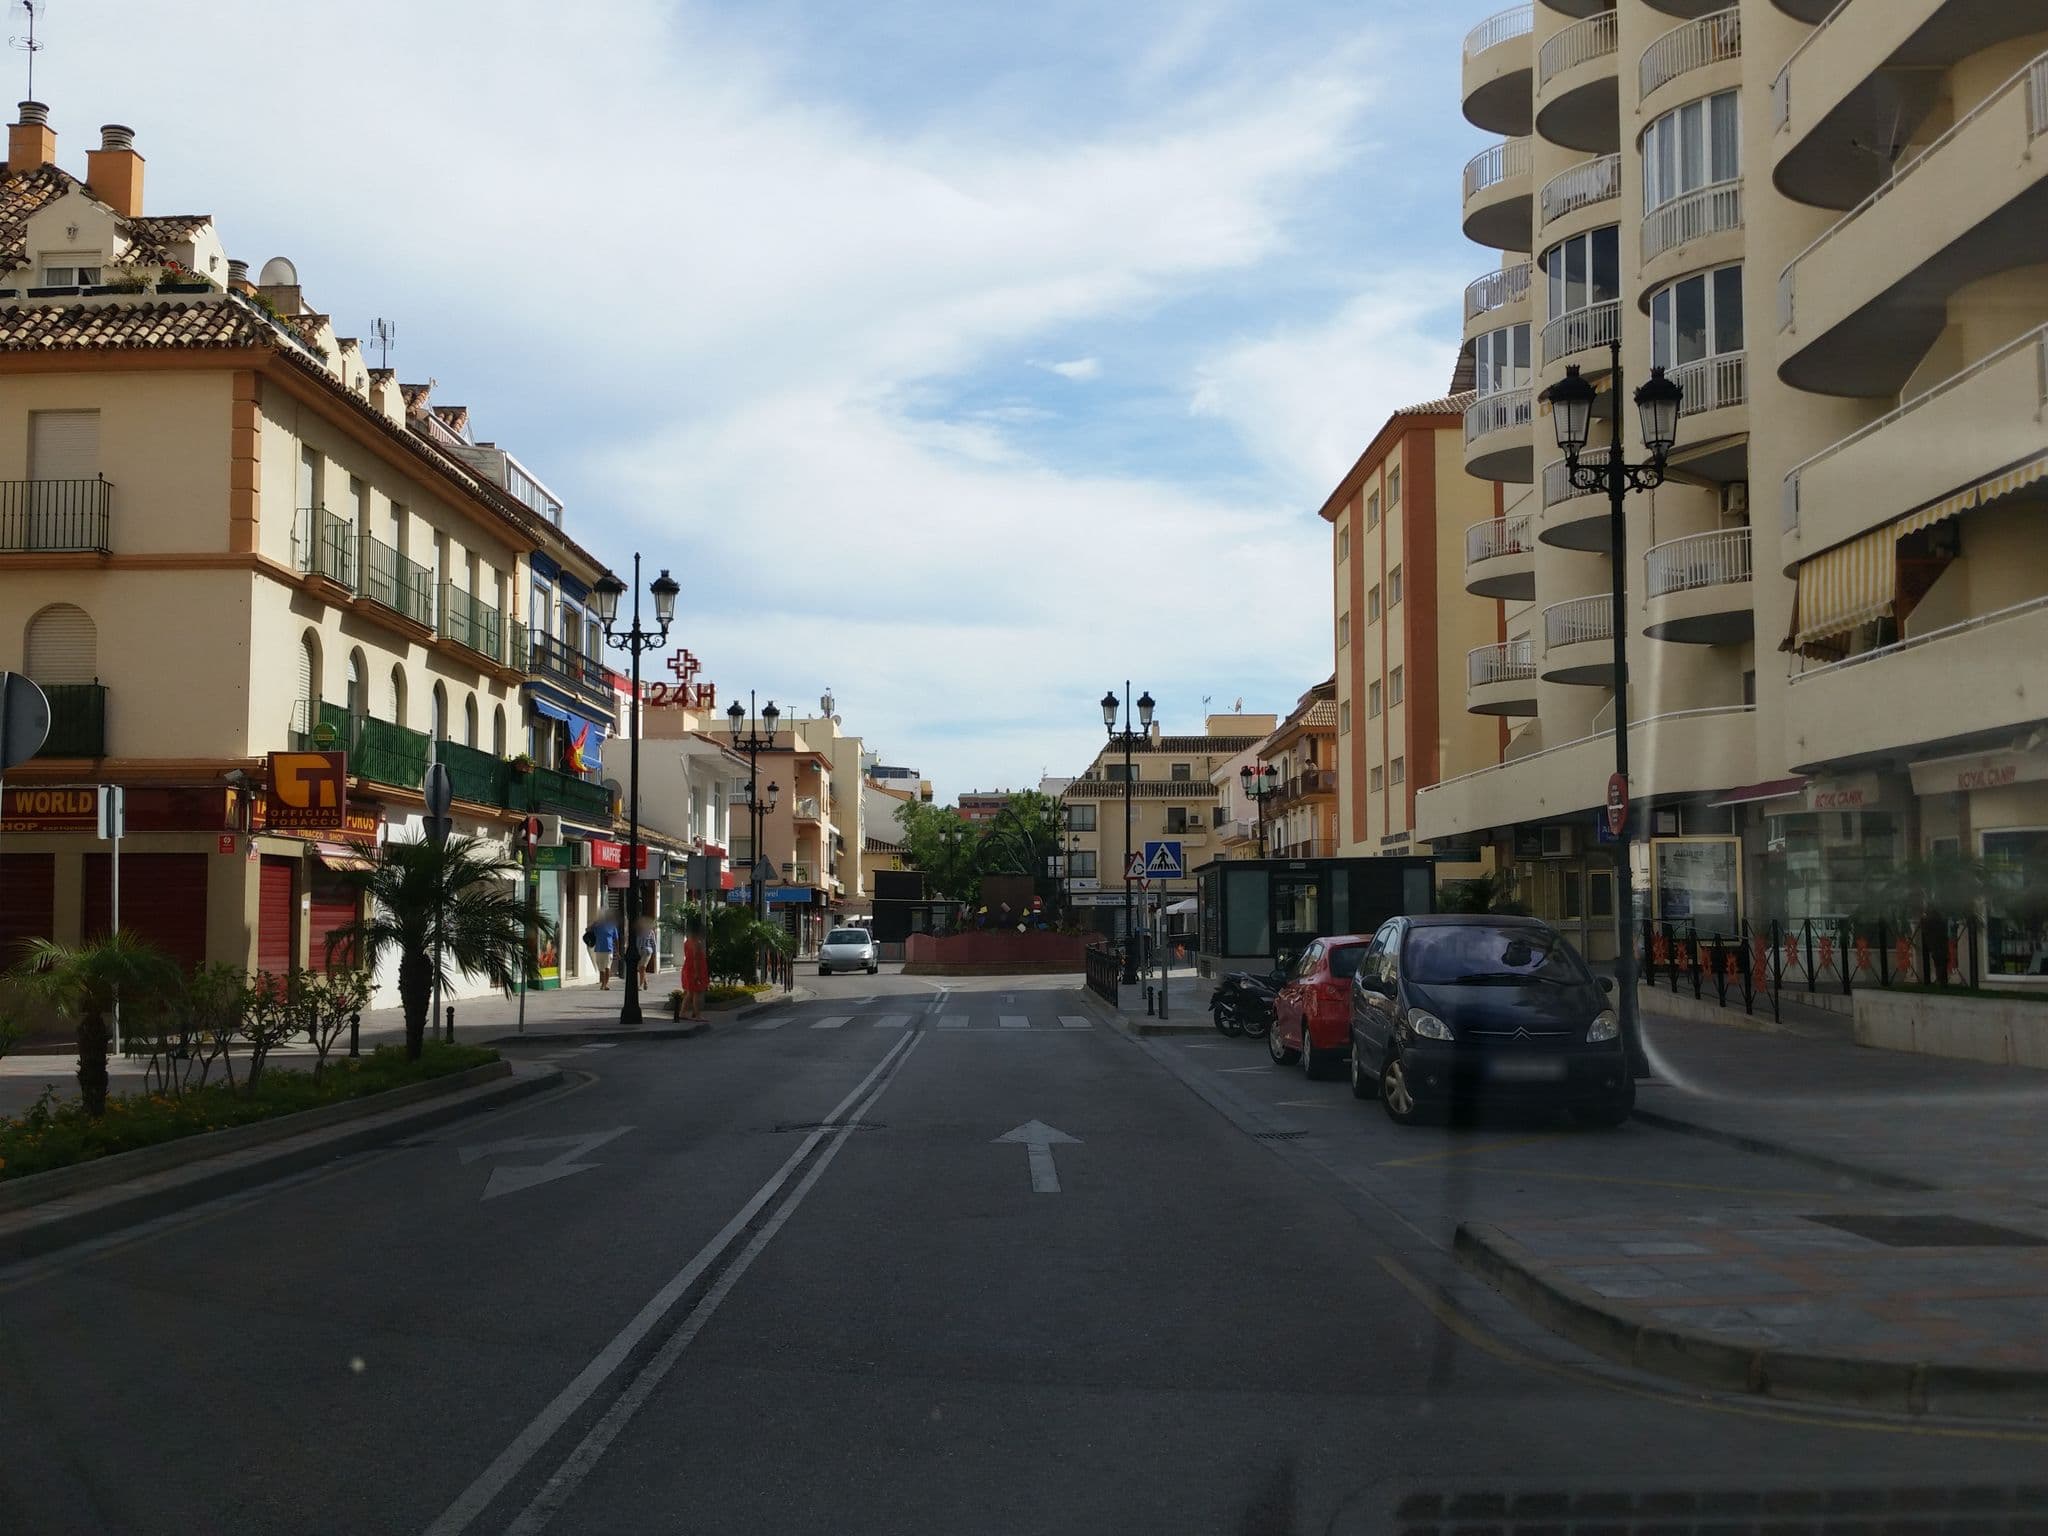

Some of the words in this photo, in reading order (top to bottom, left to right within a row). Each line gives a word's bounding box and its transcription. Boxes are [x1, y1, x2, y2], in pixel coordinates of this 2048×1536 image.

[15, 791, 94, 813] WORLD
[271, 809, 340, 817] OFFICIAL
[271, 818, 340, 826] TOBACCO
[0, 822, 38, 831] HOP
